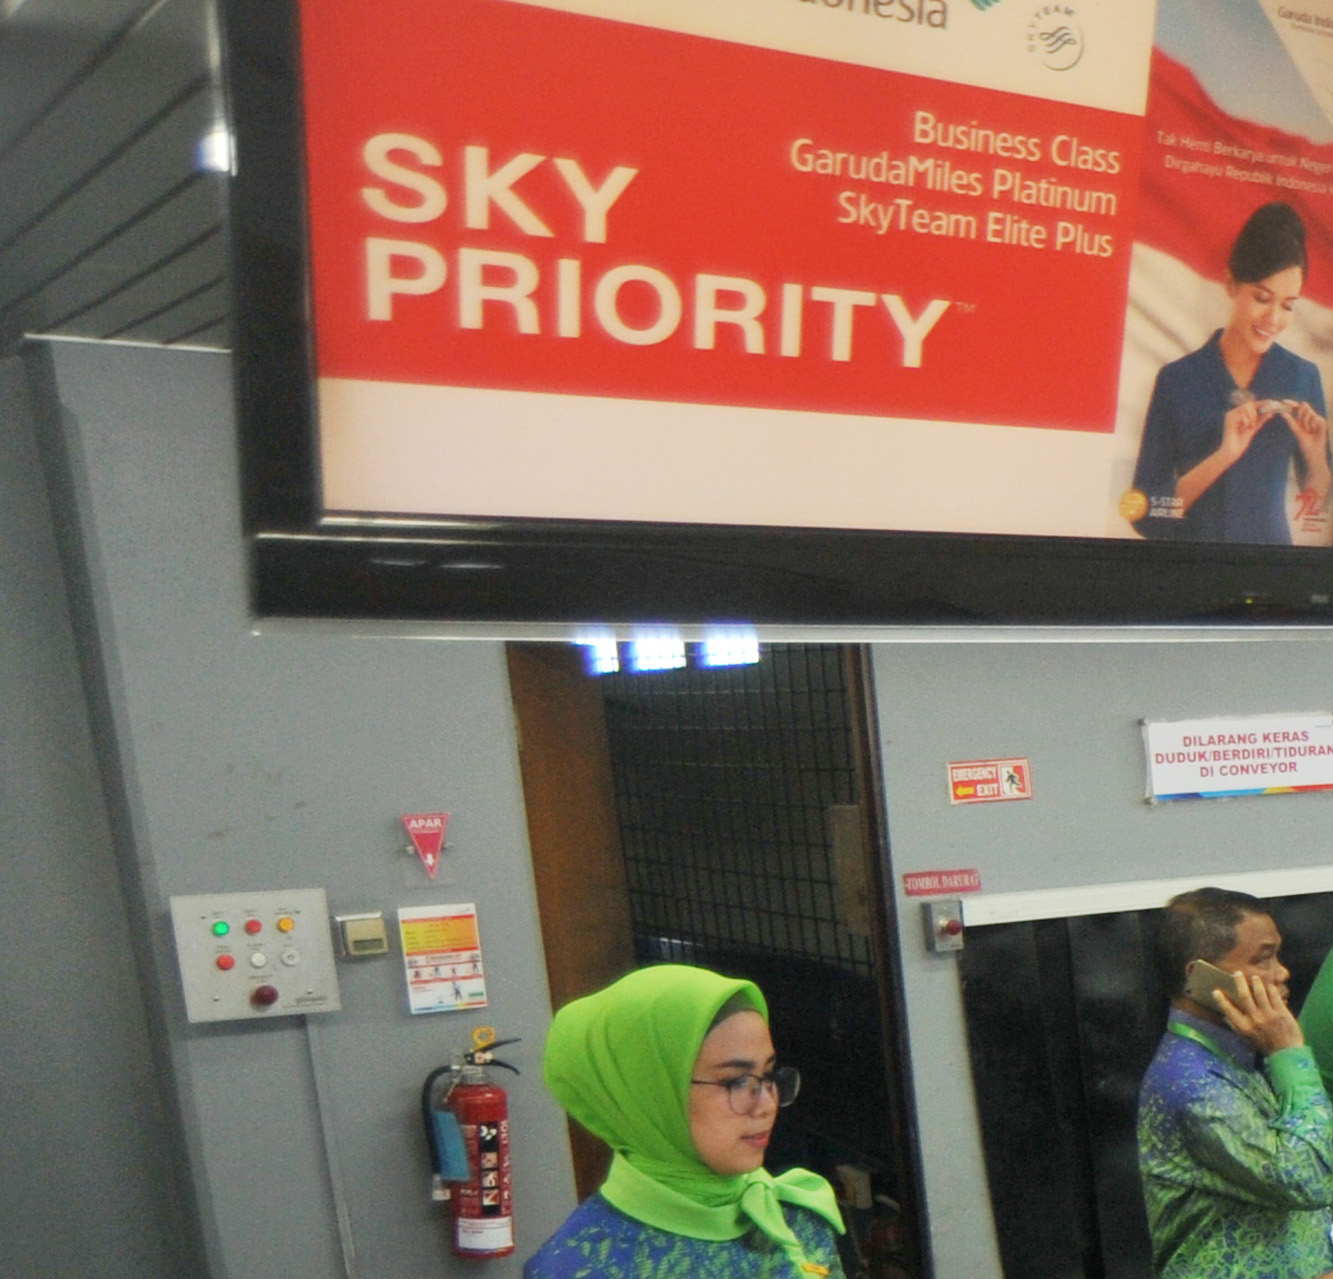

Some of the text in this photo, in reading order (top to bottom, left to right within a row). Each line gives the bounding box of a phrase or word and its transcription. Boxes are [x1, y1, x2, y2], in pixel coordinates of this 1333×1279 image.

[913, 110, 1121, 175] Business Class
[361, 132, 639, 245] SKY
[790, 138, 1118, 217] GarudaMiles Platinum
[837, 190, 1114, 258] SkyTeam Elite Plus
[364, 236, 951, 369] PRIORITY
[1183, 731, 1309, 748] DILARANG KERAS
[1200, 762, 1297, 778] DI CONVEYOR
[976, 783, 998, 797] EXIT
[410, 818, 442, 828] APAR
